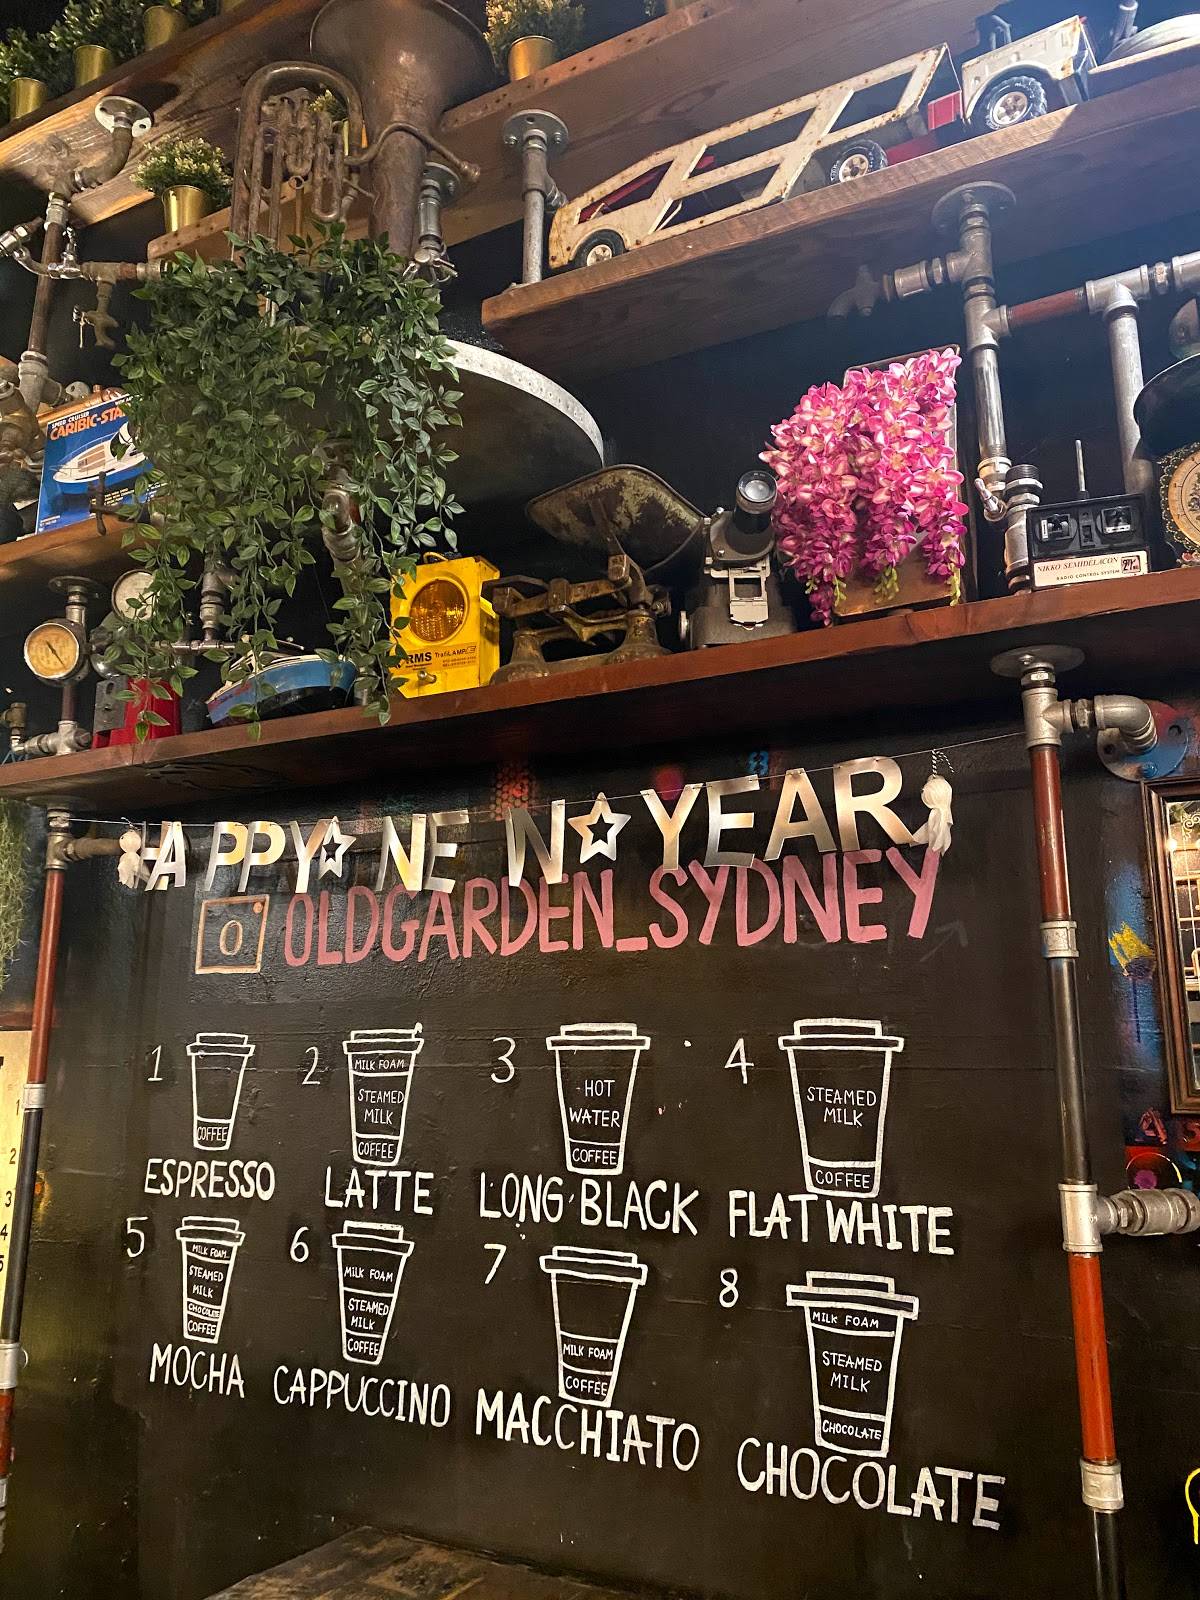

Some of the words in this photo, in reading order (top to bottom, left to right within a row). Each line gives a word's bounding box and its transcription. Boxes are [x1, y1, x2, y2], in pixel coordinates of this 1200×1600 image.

[50, 406, 126, 441] CARIBIC-STA
[51, 419, 67, 429] SPEED
[67, 411, 90, 423] CRUISER
[1038, 564, 1061, 573] NIKKO
[640, 756, 917, 871] YEAR
[283, 846, 940, 967] OLDGARDEN_SYDNEY
[147, 1044, 163, 1081] 1
[302, 1046, 321, 1085] 2
[354, 1059, 375, 1071] MILK
[379, 1058, 405, 1070] FOAM
[490, 1037, 516, 1083] 3
[724, 1038, 755, 1084] 4
[357, 1088, 404, 1104] STEAMED
[585, 1079, 615, 1099] HOT
[806, 1086, 877, 1106] STEAMED
[364, 1109, 393, 1125] MILK
[569, 1107, 621, 1127] WATER
[823, 1107, 863, 1127] MILK
[197, 1126, 228, 1142] COFFEE
[357, 1142, 395, 1158] COFFEE
[572, 1147, 618, 1166] COFFEE
[144, 1158, 275, 1200] ESPRESSO
[815, 1169, 870, 1189] COFFEE
[325, 1166, 434, 1215] LATTE
[479, 1172, 564, 1224] LONG
[579, 1178, 700, 1236] BLACK
[728, 1190, 821, 1239] FLAT
[826, 1200, 954, 1255] WHITE
[126, 1216, 148, 1257] 5
[289, 1226, 310, 1262] 6
[192, 1244, 208, 1256] MILK
[189, 1265, 224, 1282] STEAMED
[483, 1244, 506, 1284] 7
[369, 1268, 393, 1282] FOAM
[192, 1284, 213, 1298] MILK
[718, 1268, 739, 1308] 8
[348, 1298, 389, 1316] STEAMED
[187, 1320, 216, 1336] COFFEE
[351, 1316, 376, 1331] MILK
[844, 1315, 880, 1329] FOAM
[347, 1338, 380, 1357] COFFEE
[563, 1343, 584, 1357] MILK
[588, 1346, 614, 1361] FOAM
[149, 1343, 245, 1398] MOCHA
[821, 1350, 883, 1373] STEAMED
[565, 1375, 608, 1397] COFFEE
[830, 1372, 871, 1393] MILK
[273, 1365, 451, 1428] CAPPUCCINO
[475, 1388, 700, 1472] MACCHIATO
[822, 1419, 882, 1441] CHOCOLATE
[737, 1437, 1006, 1530] CHOCOLATE
